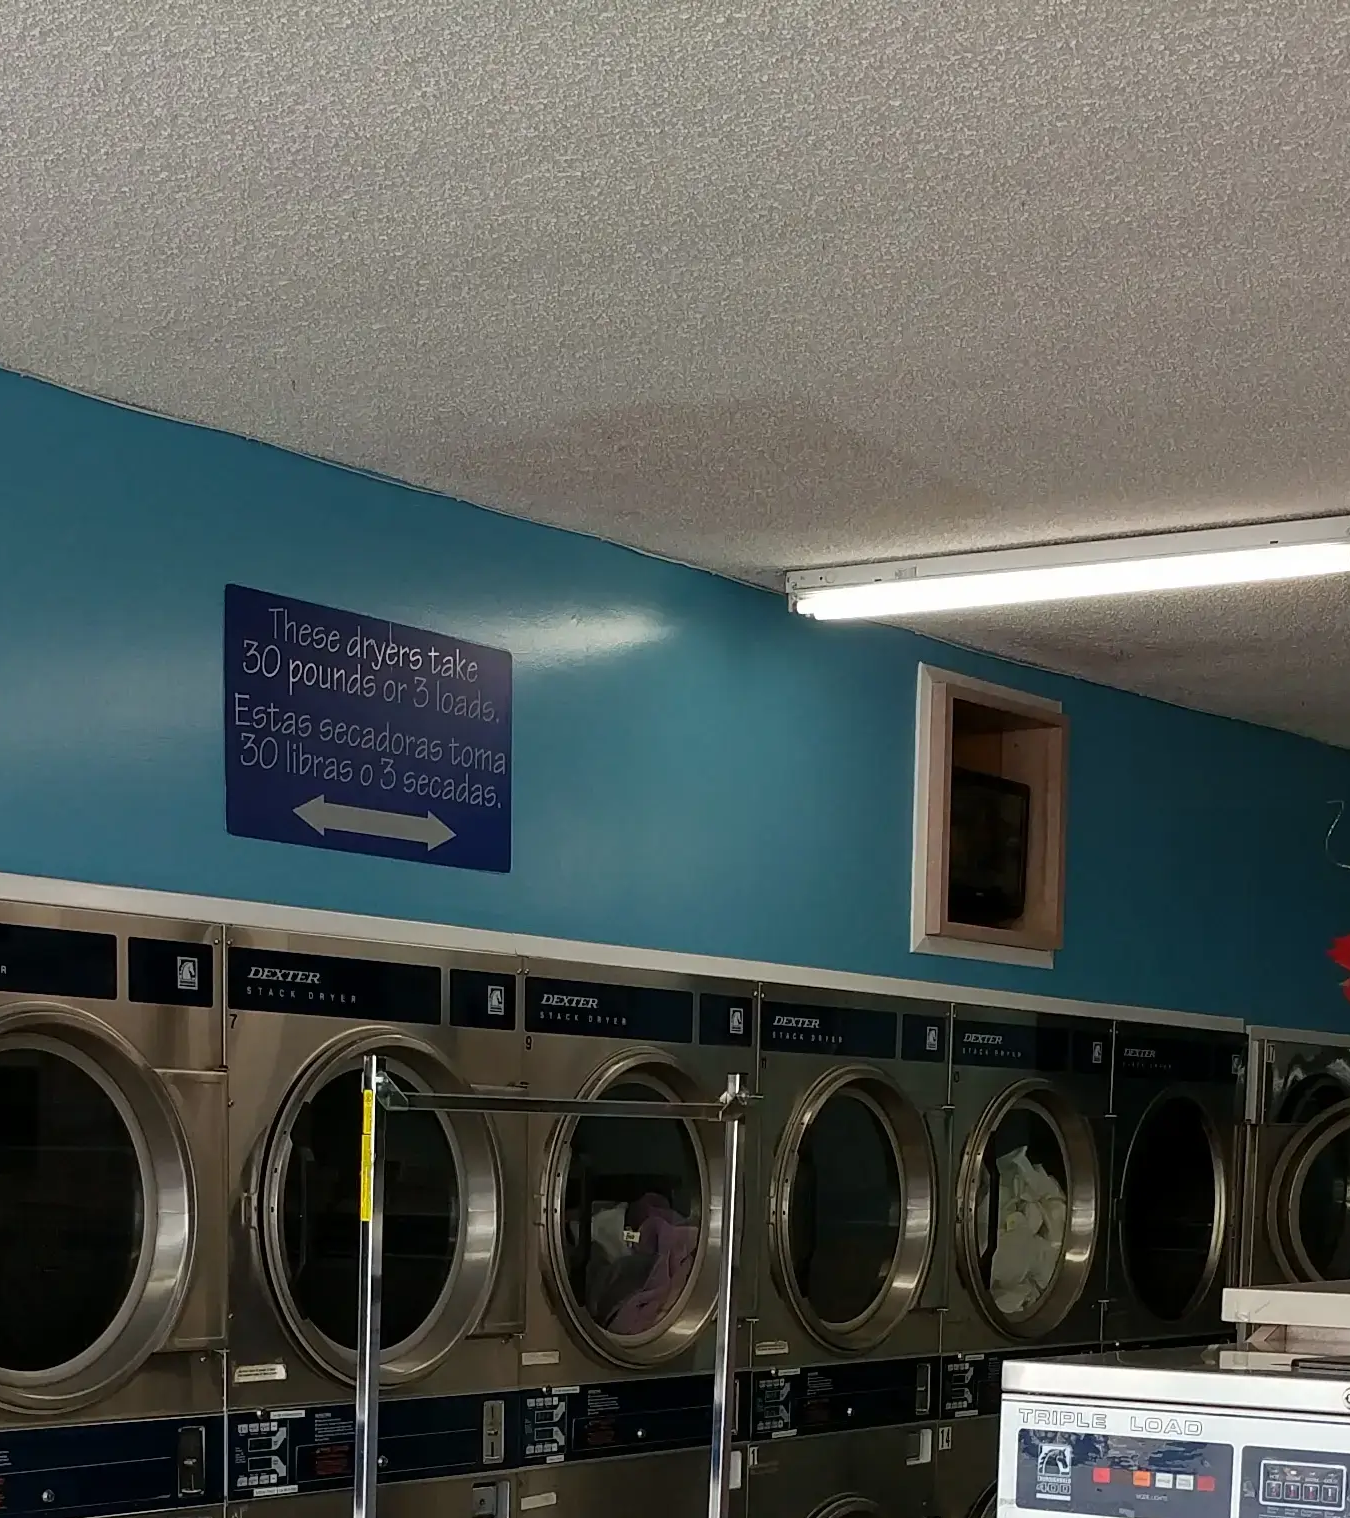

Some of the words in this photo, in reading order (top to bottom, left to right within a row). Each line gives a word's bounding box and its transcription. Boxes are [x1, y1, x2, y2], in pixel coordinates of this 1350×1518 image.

[268, 606, 341, 653] These
[346, 625, 424, 672] dryers
[428, 646, 479, 684] take
[242, 639, 281, 678] 30
[288, 657, 376, 698] pounds
[383, 679, 409, 704] or
[413, 676, 430, 708] 3
[436, 681, 501, 725] loads.
[234, 692, 313, 738] Estas
[319, 717, 444, 763] secadoras
[448, 737, 507, 775] toma
[240, 732, 279, 770] 30
[286, 739, 353, 783] libras
[360, 764, 374, 787] o
[380, 758, 397, 790] 3
[403, 770, 503, 809] secadas.
[247, 966, 322, 984] DEXTER
[246, 986, 296, 999] STACK
[308, 991, 357, 1004] DRYER
[540, 993, 600, 1009] DEXTER
[229, 1013, 238, 1030] 7
[772, 1015, 820, 1029] DEXTER
[524, 1035, 533, 1051] 9
[1018, 1408, 1107, 1430] TRIPLE
[1129, 1415, 1203, 1436] LOAD
[1035, 1482, 1071, 1495] 400
